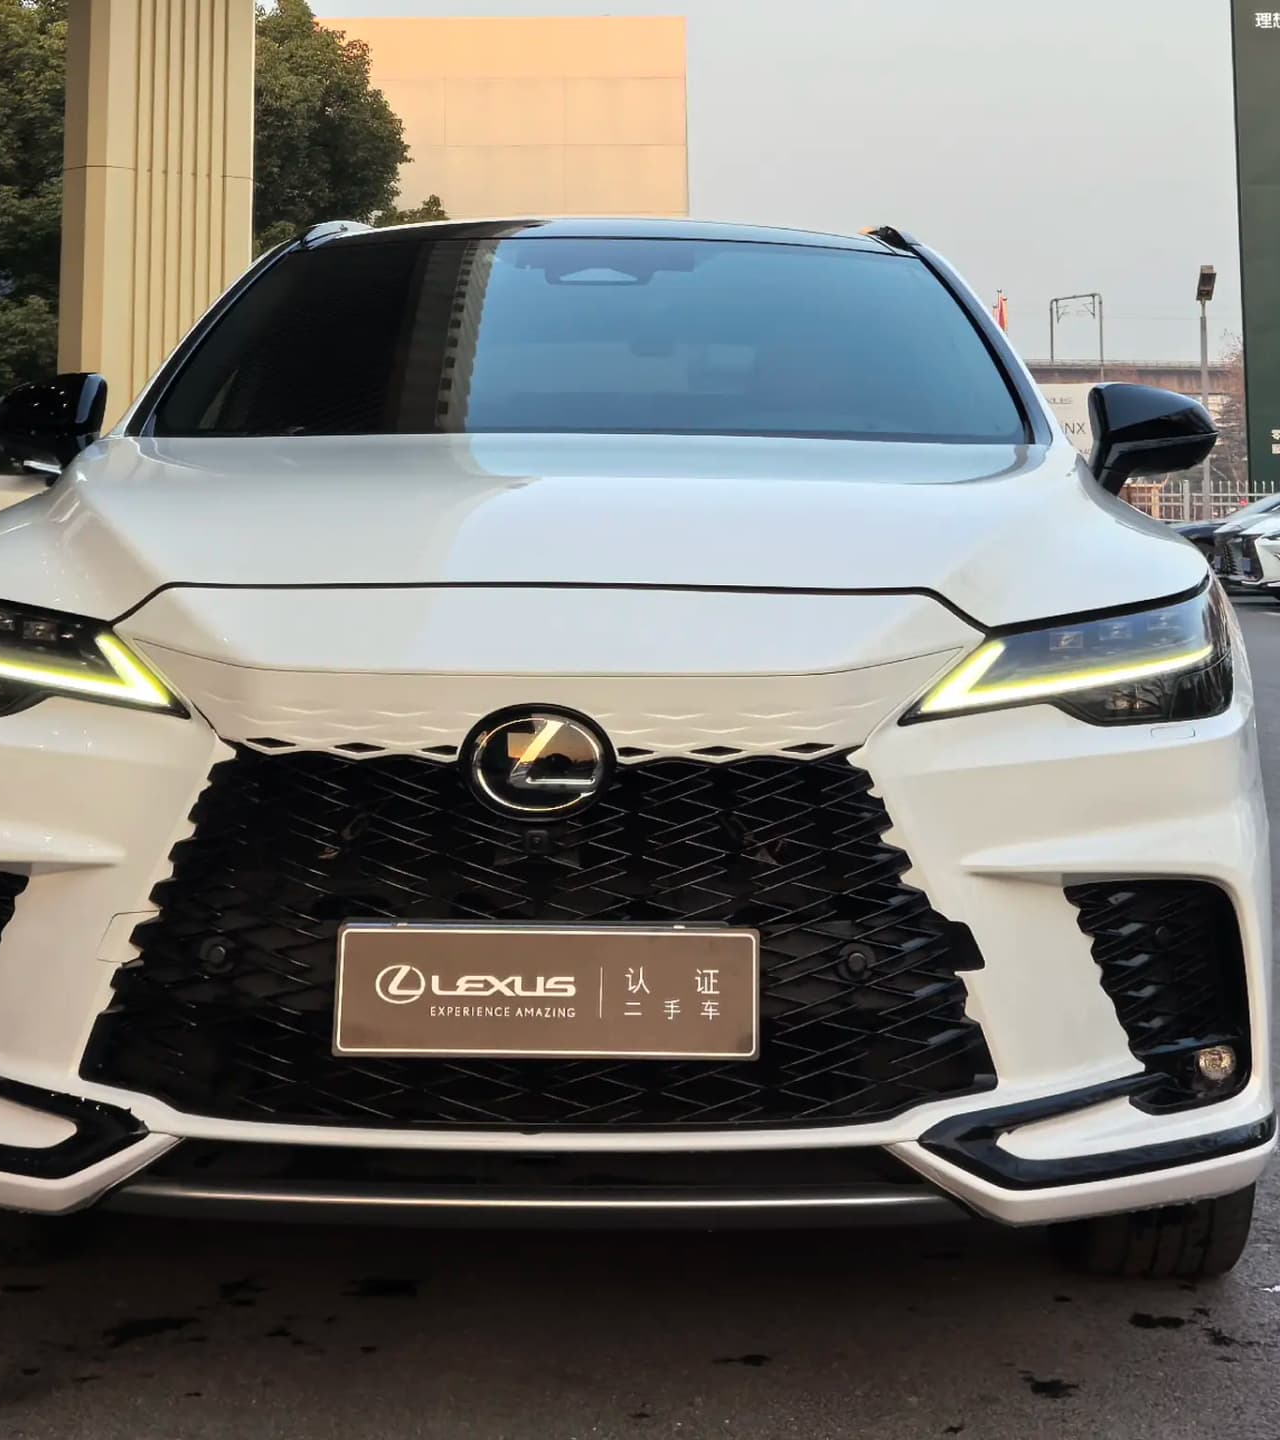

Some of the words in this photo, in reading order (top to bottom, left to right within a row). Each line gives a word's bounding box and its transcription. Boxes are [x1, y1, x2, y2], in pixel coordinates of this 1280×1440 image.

[431, 975, 576, 997] LEXUS
[625, 966, 720, 994] 认证
[430, 1006, 510, 1017] EXPERIENCE
[515, 1007, 576, 1019] AMAZING
[624, 999, 720, 1021] 二手车
